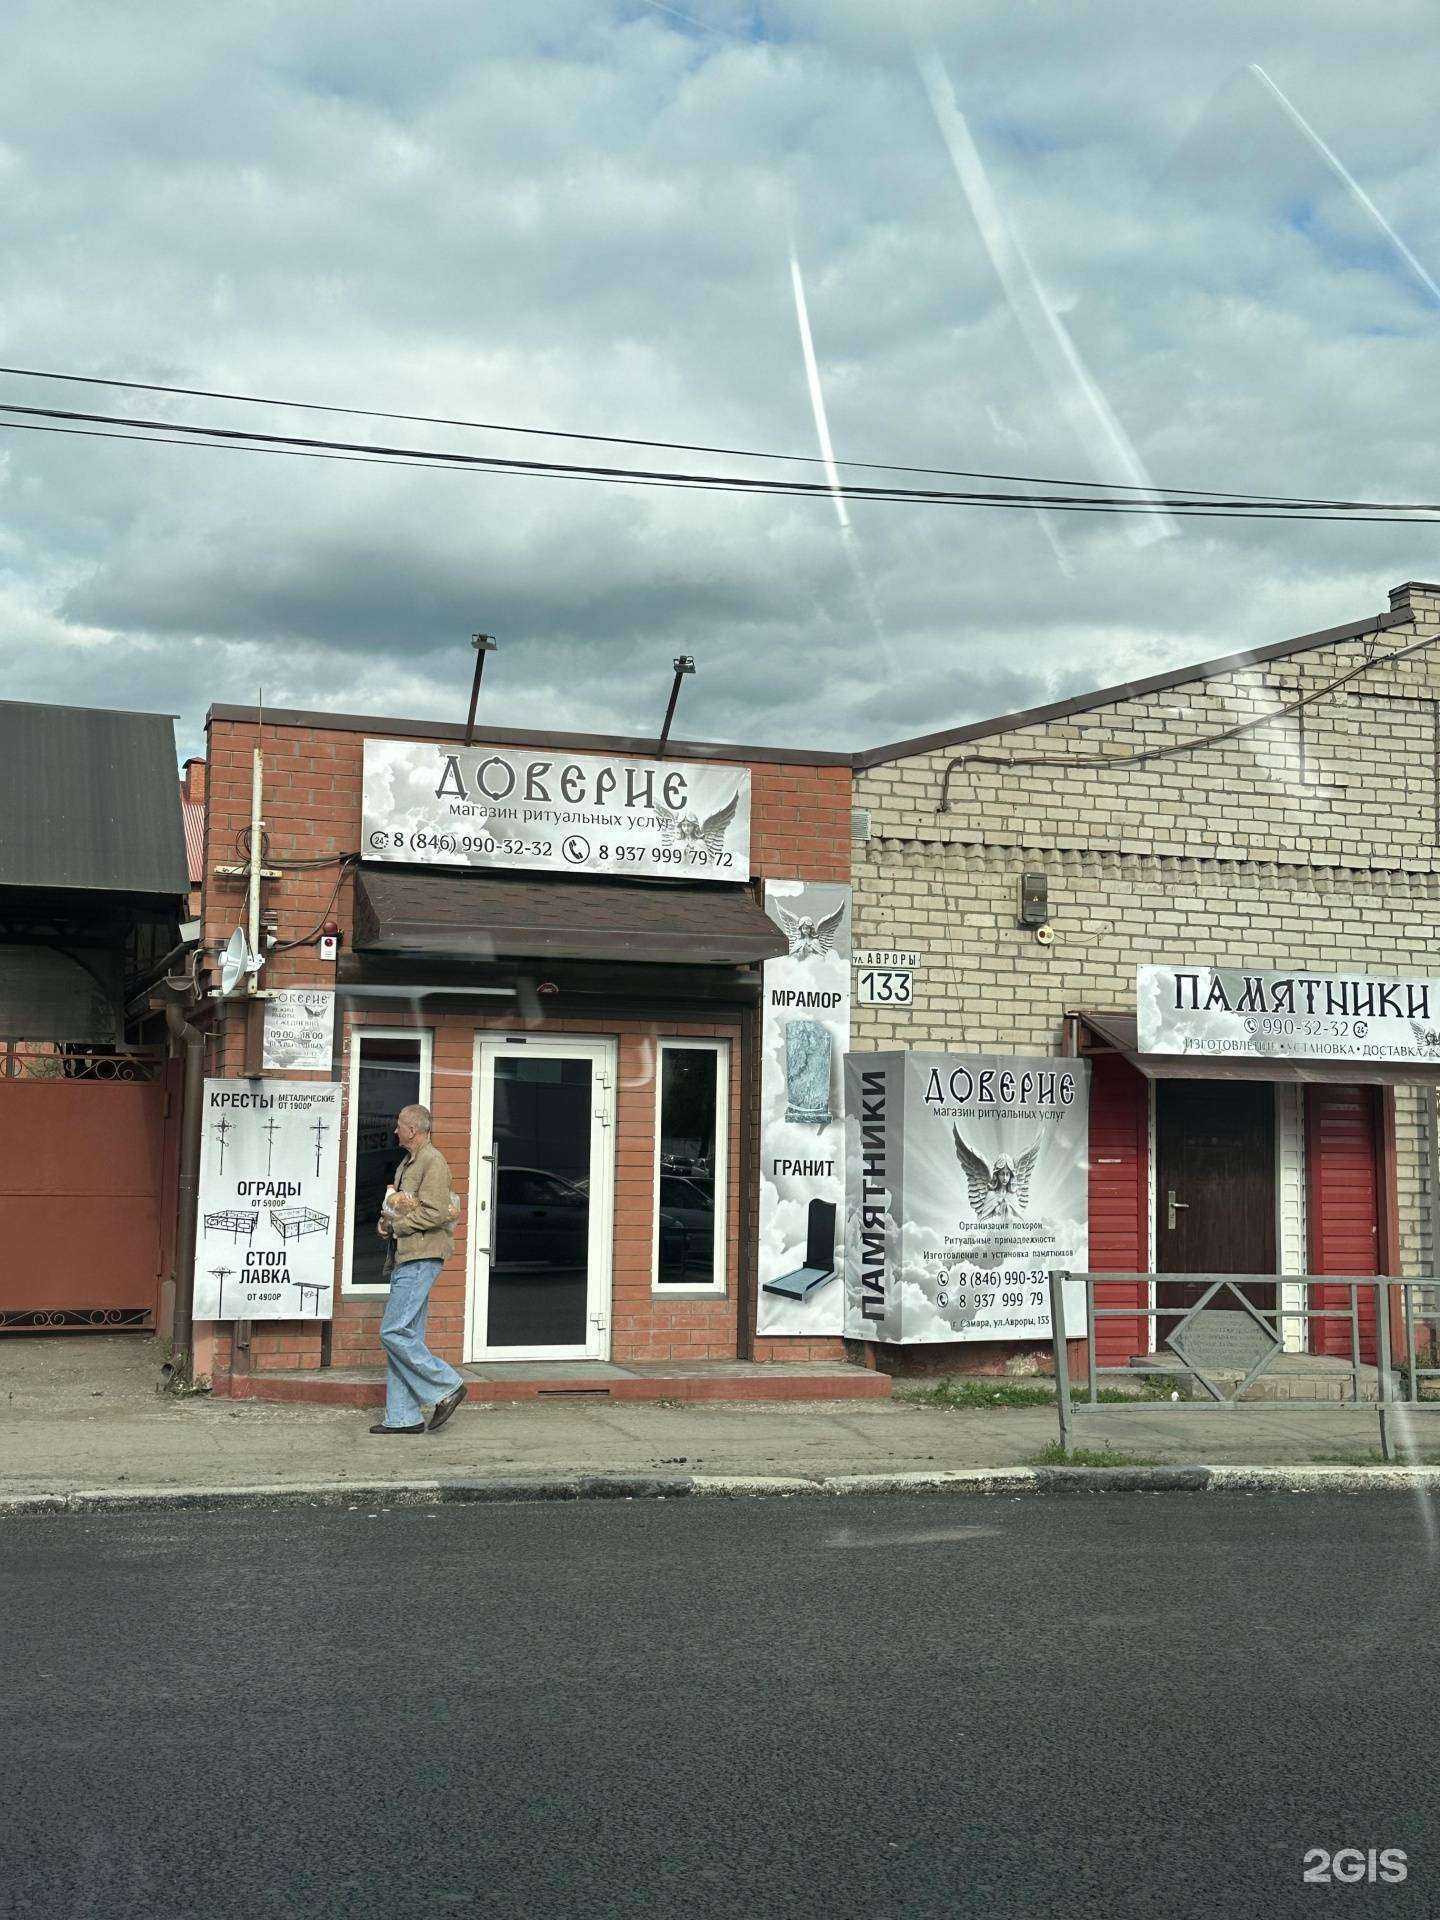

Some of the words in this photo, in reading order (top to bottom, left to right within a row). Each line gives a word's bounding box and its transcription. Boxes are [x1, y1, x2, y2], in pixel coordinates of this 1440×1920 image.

[434, 755, 688, 810] ДОВЕРИЕ
[449, 804, 518, 819] магазин
[523, 809, 623, 825] ритуальных
[628, 815, 673, 831] услуг
[393, 832, 404, 848] 8
[410, 833, 457, 854] (846)
[462, 836, 553, 856] 990-32-32
[599, 844, 609, 860] 8
[615, 845, 646, 862] 937
[651, 847, 682, 864] 999
[688, 849, 708, 866] 79
[713, 851, 734, 868] 72
[867, 952, 917, 966] АВРОРЫ
[861, 972, 910, 1001] 133
[771, 988, 843, 1010] МРАМОР
[1174, 974, 1431, 1019] ПАМЯТНИКИ
[1262, 1018, 1349, 1037] 990-32-32
[924, 1067, 1075, 1105] ДОВЕРИЕ
[210, 1093, 274, 1109] КРЕСТЫ
[933, 1107, 975, 1117] магазин
[978, 1108, 1037, 1120] ритуальных
[1040, 1109, 1066, 1122] услуг
[773, 1158, 835, 1178] ГРАНИТ
[237, 1180, 302, 1199] ОГРАДЫ
[861, 1071, 886, 1321] ПАМЯТНИКИ
[251, 1199, 261, 1207] ОТ
[959, 1221, 1010, 1231] Организация
[944, 1235, 992, 1245] Ритуальные
[245, 1250, 287, 1267] СТОЛ
[923, 1250, 979, 1261] Изготовление
[992, 1251, 1029, 1260] установка
[239, 1268, 291, 1284] ЛАВКА
[959, 1272, 967, 1287] 8
[970, 1271, 1001, 1288] (846)
[1004, 1270, 1049, 1286] 990-32-
[247, 1292, 256, 1301] ОТ
[959, 1294, 967, 1309] 8
[974, 1293, 995, 1308] 937
[1002, 1292, 1023, 1307] 999
[1029, 1292, 1043, 1306] 79
[960, 1318, 992, 1329] Самара,
